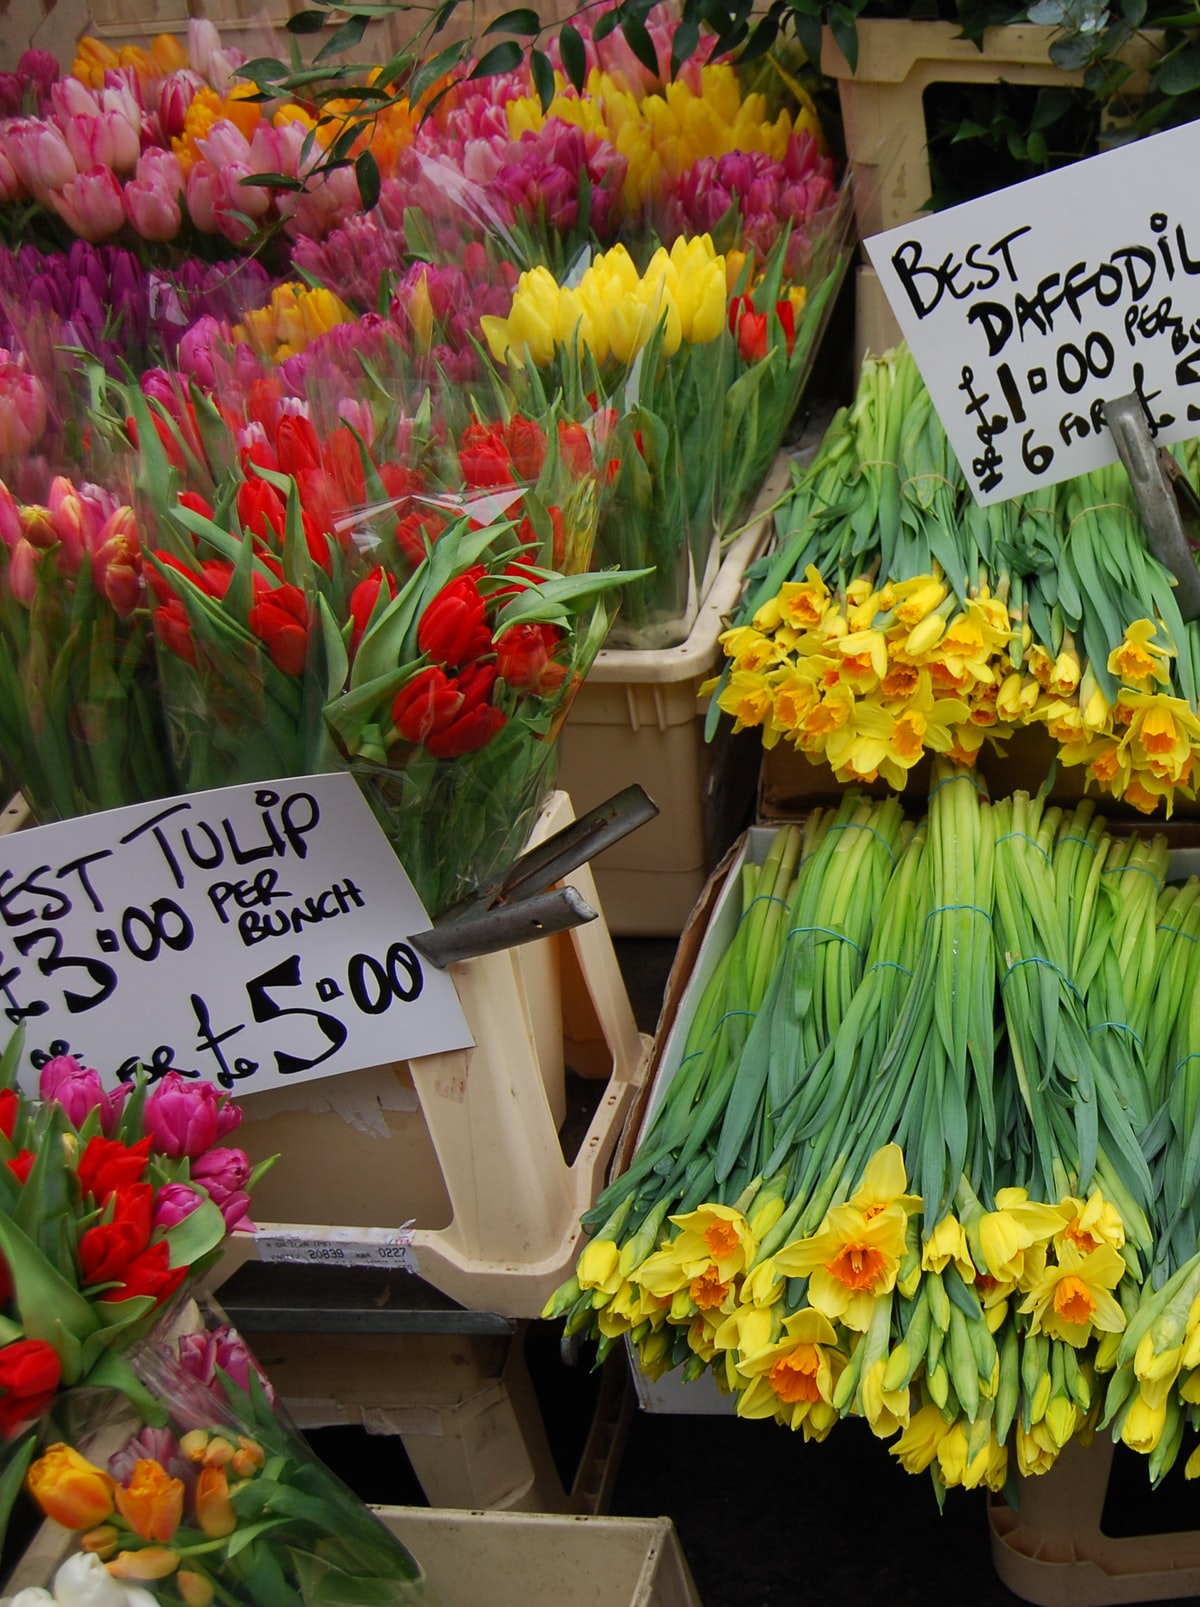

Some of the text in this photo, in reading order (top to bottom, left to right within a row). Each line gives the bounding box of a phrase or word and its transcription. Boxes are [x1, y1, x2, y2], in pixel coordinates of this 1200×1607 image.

[892, 226, 1032, 319] BEST
[1124, 296, 1183, 346] PER
[1021, 428, 1055, 475] 6
[1059, 398, 1110, 447] FOR
[207, 868, 293, 923] PER
[238, 878, 367, 947] BUNCH
[308, 1248, 345, 1260] 20839
[378, 1247, 406, 1258] 0227
